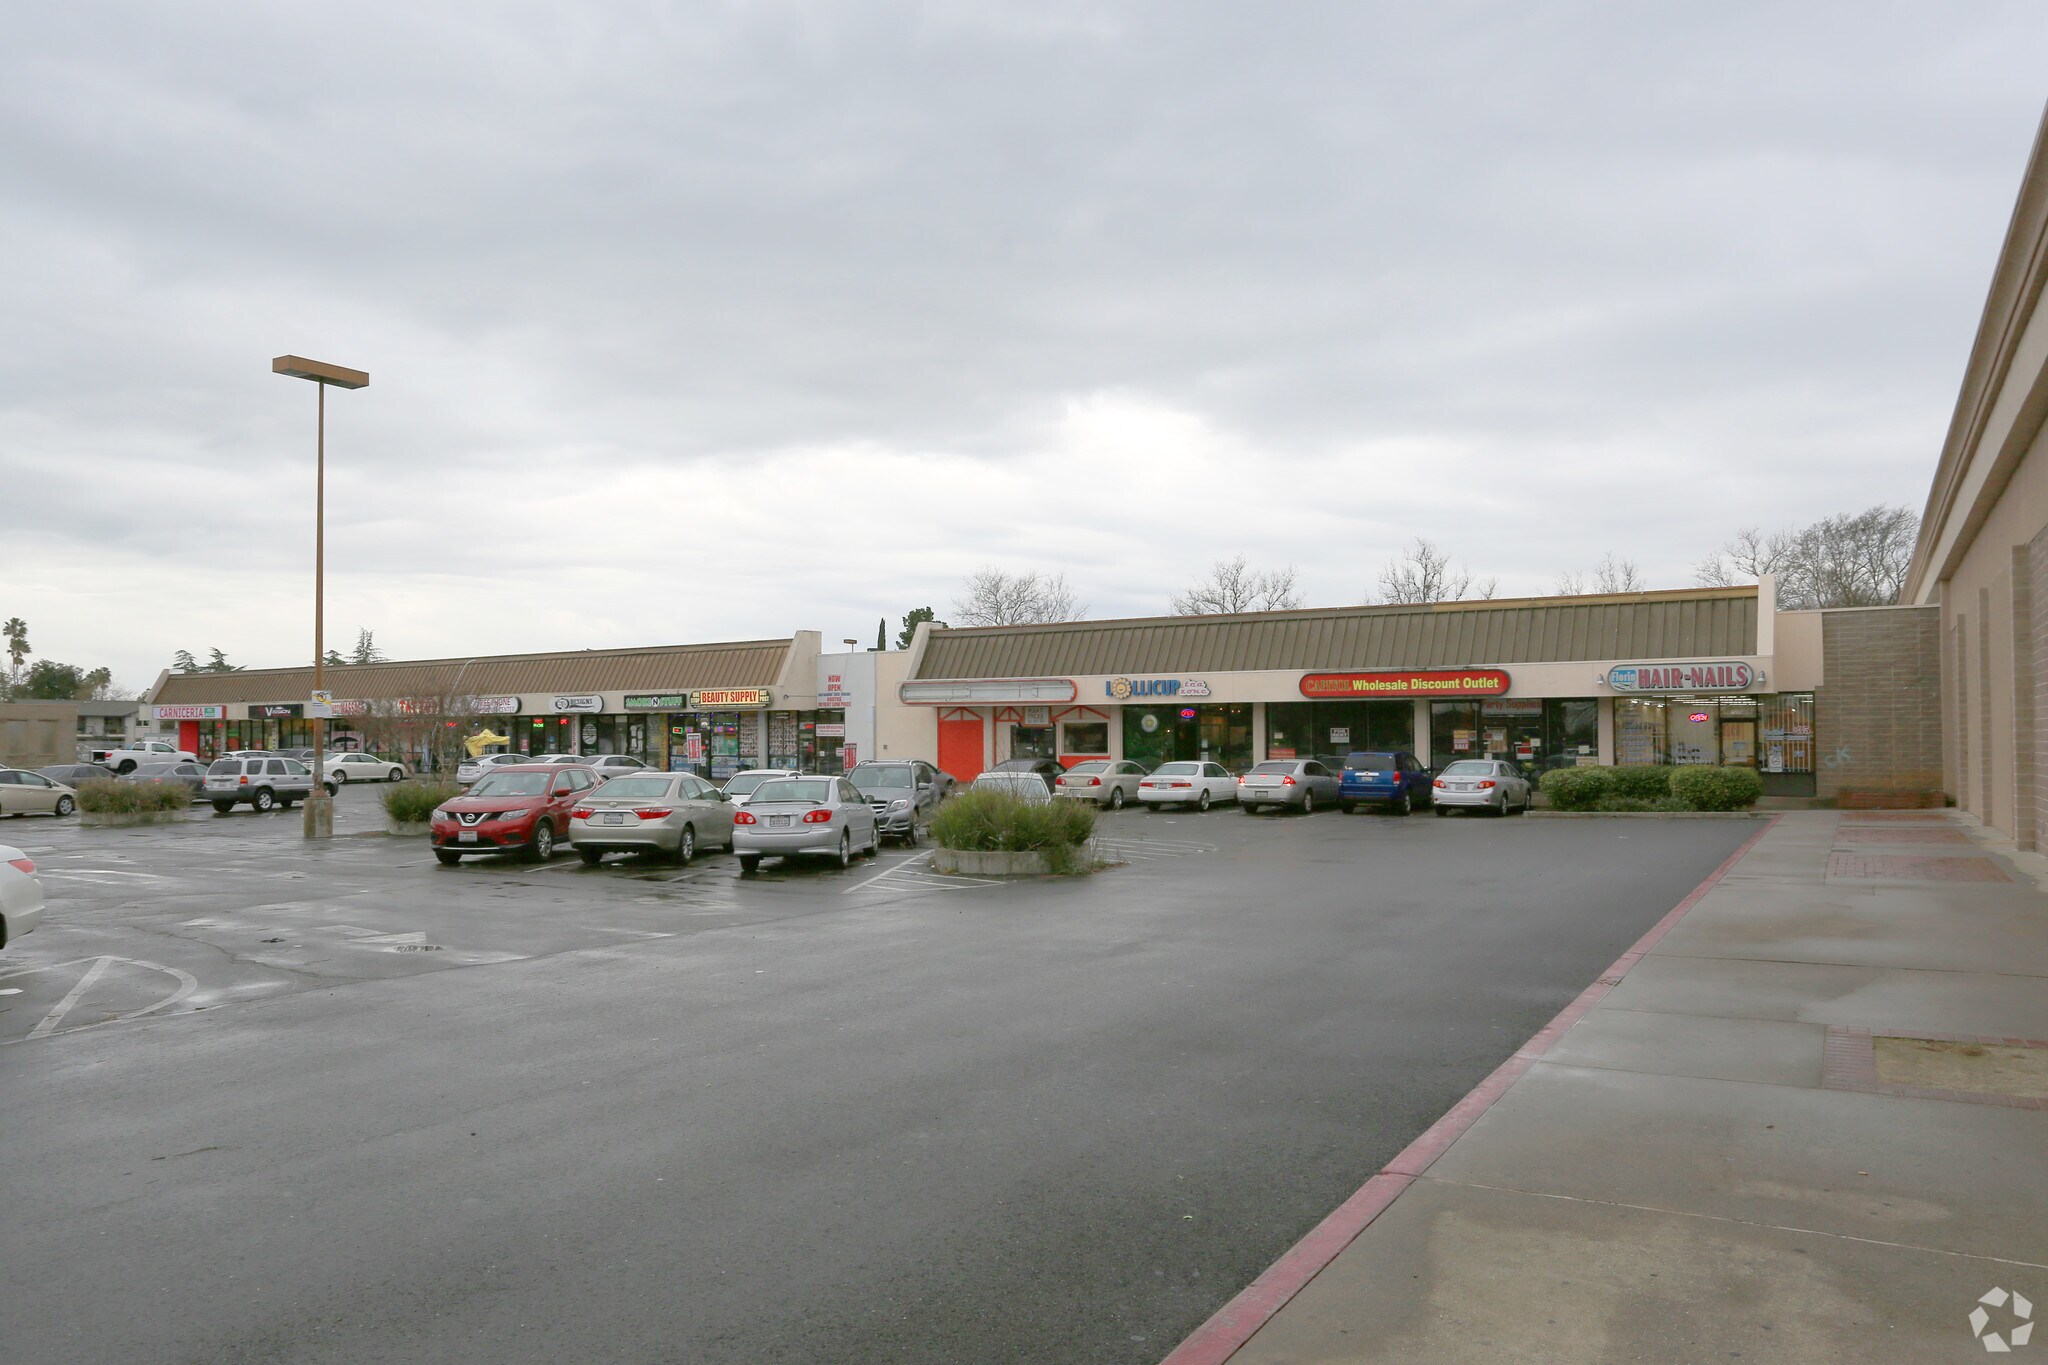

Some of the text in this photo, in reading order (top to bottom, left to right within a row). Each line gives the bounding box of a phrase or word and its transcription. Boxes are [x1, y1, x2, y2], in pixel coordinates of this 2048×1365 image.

[827, 675, 841, 683] NOW
[1611, 665, 1749, 689] Florin HAIR-NAILS
[827, 684, 842, 692] OPEN
[1184, 679, 1204, 688] tea
[1305, 677, 1499, 692] CAPITOL Wholesale Discount Outlet
[659, 696, 683, 706] STUFF
[701, 691, 729, 703] BEAUTY
[730, 691, 757, 702] SUPPLY
[159, 707, 204, 718] CARNICERIA
